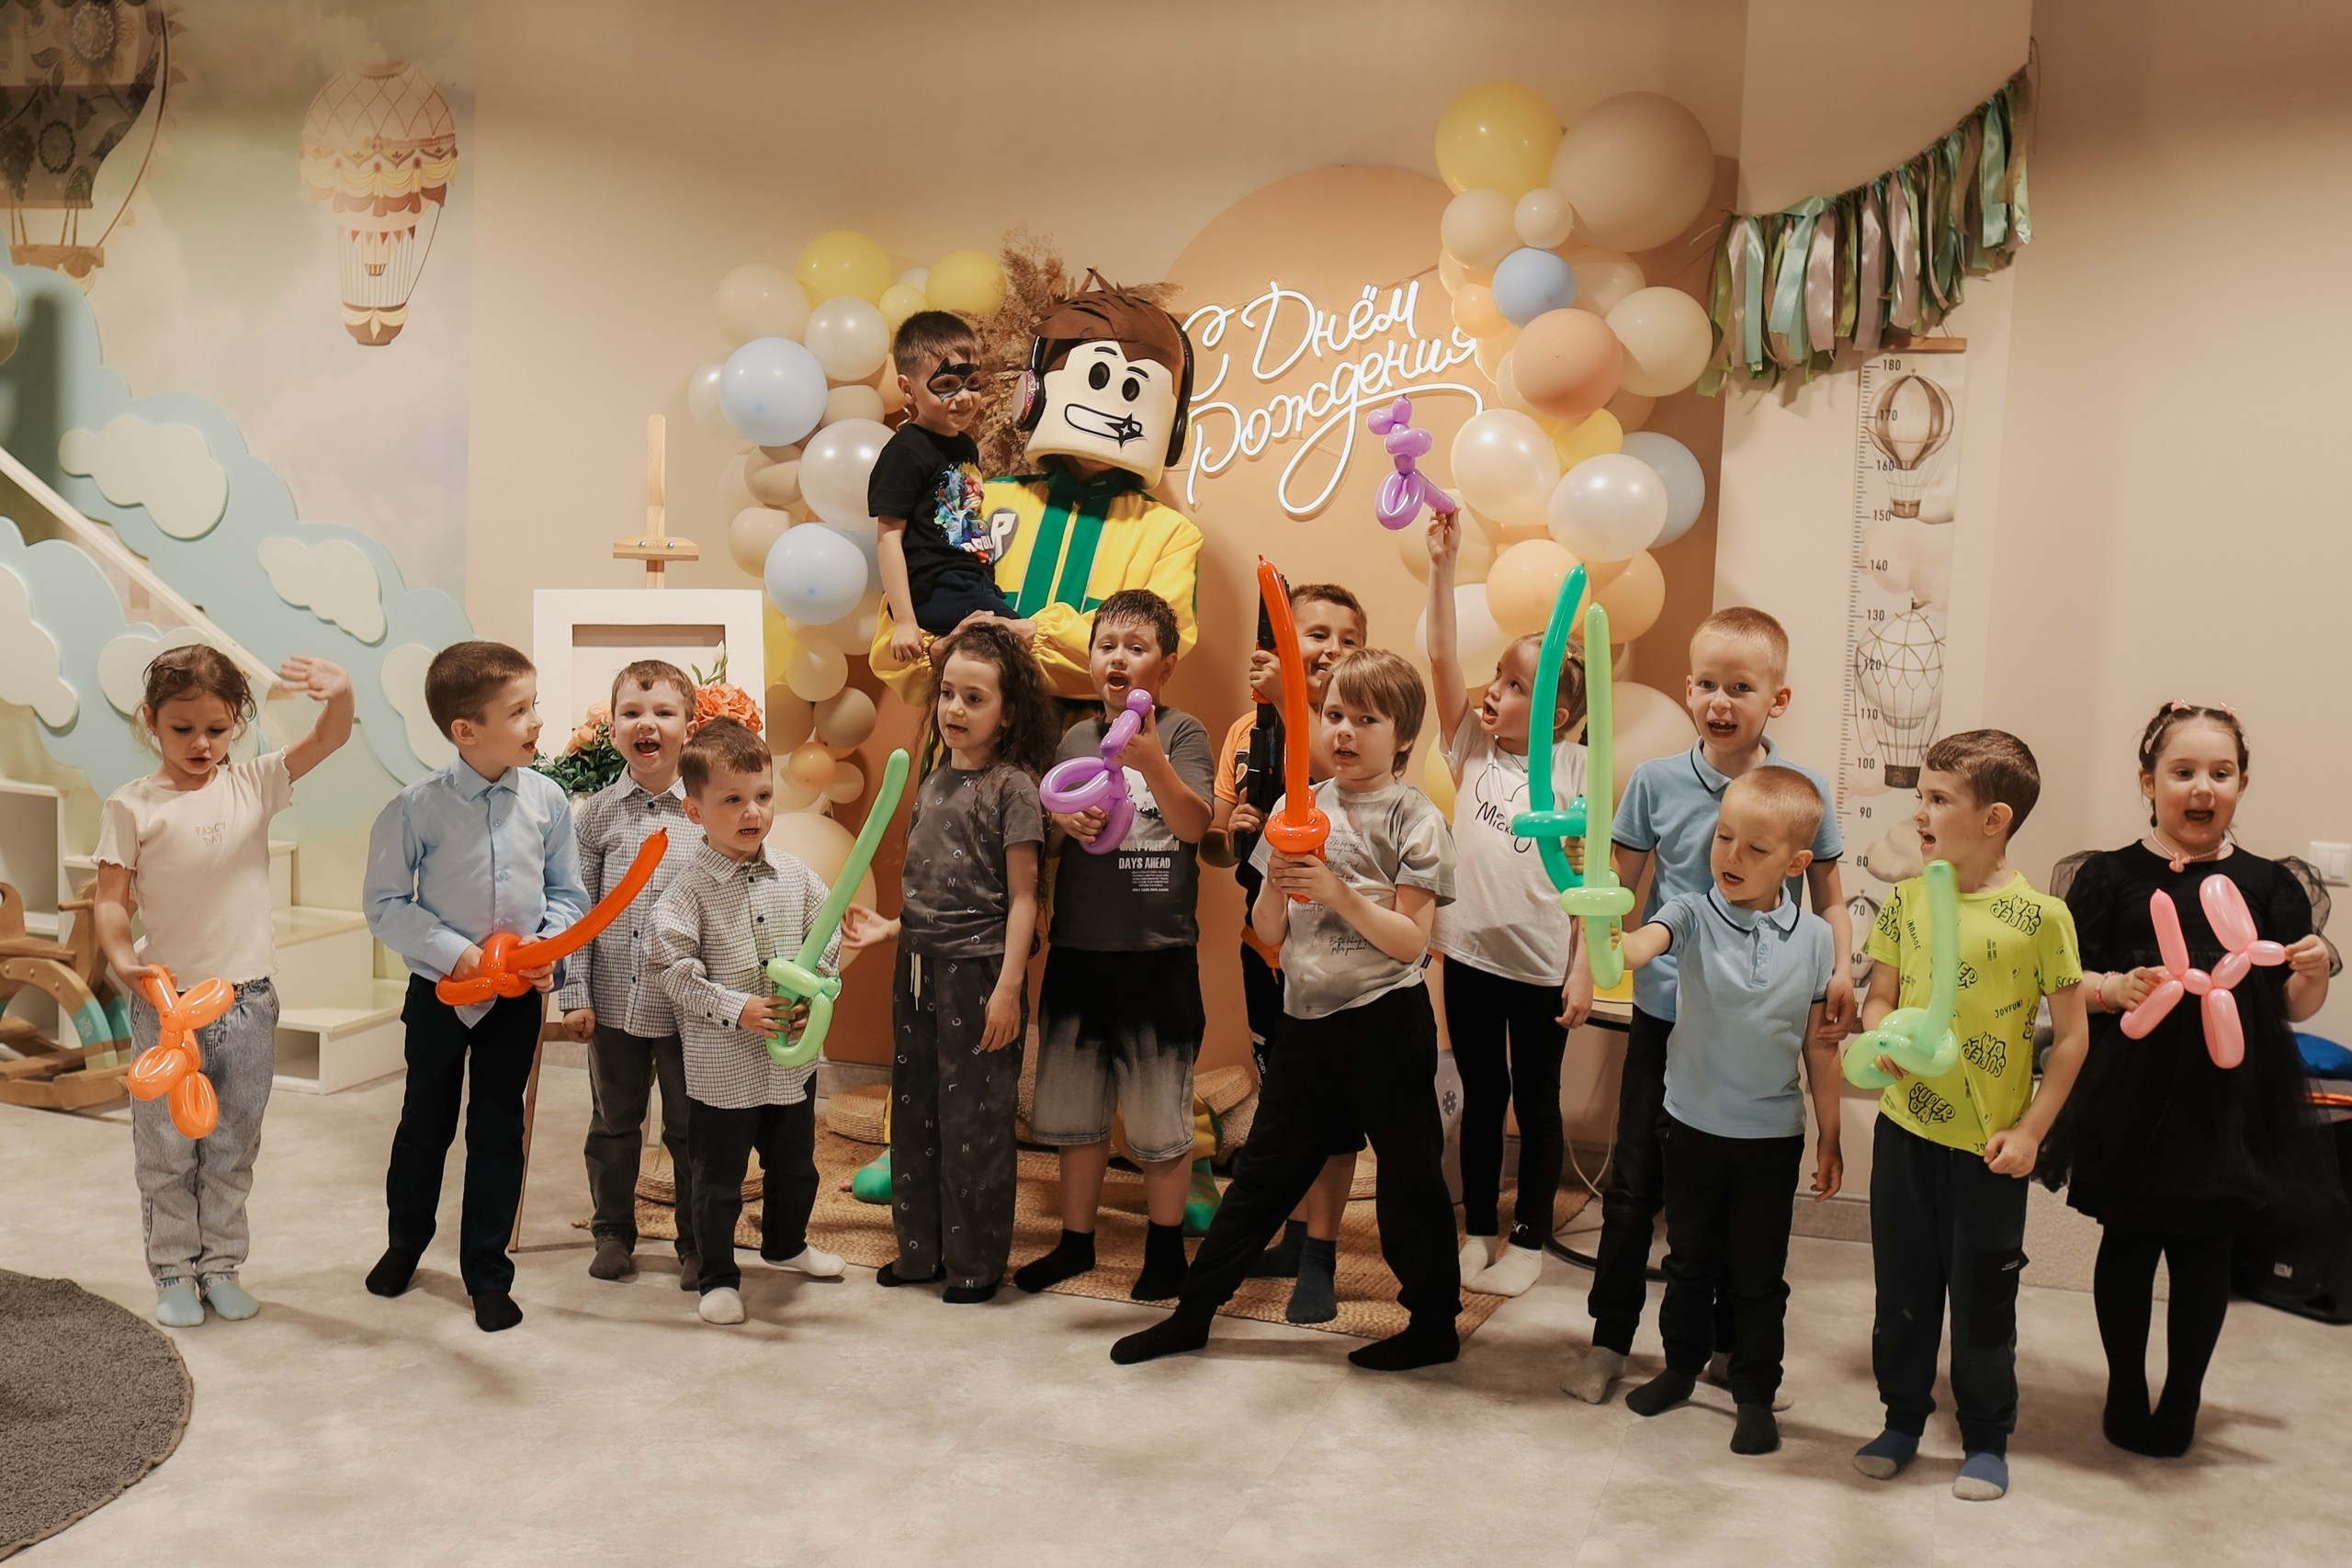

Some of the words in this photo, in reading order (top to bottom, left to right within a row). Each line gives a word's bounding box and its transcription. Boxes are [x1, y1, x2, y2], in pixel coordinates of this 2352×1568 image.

[1883, 359, 1901, 371] 180
[1880, 410, 1898, 422] 170
[1877, 460, 1894, 471] 160
[1873, 510, 1892, 522] 150
[1871, 559, 1888, 571] 140
[1867, 609, 1884, 621] 130
[1864, 659, 1882, 671] 120
[1860, 708, 1878, 720] 110
[1857, 758, 1875, 770] 100
[1860, 807, 1872, 818] 90
[1118, 858, 1143, 869] DAYS
[1145, 857, 1171, 869] AHEAD
[1856, 856, 1869, 868] 80
[1853, 905, 1866, 917] 70
[1850, 953, 1862, 964] 60
[1909, 1082, 1956, 1123] SUPER
